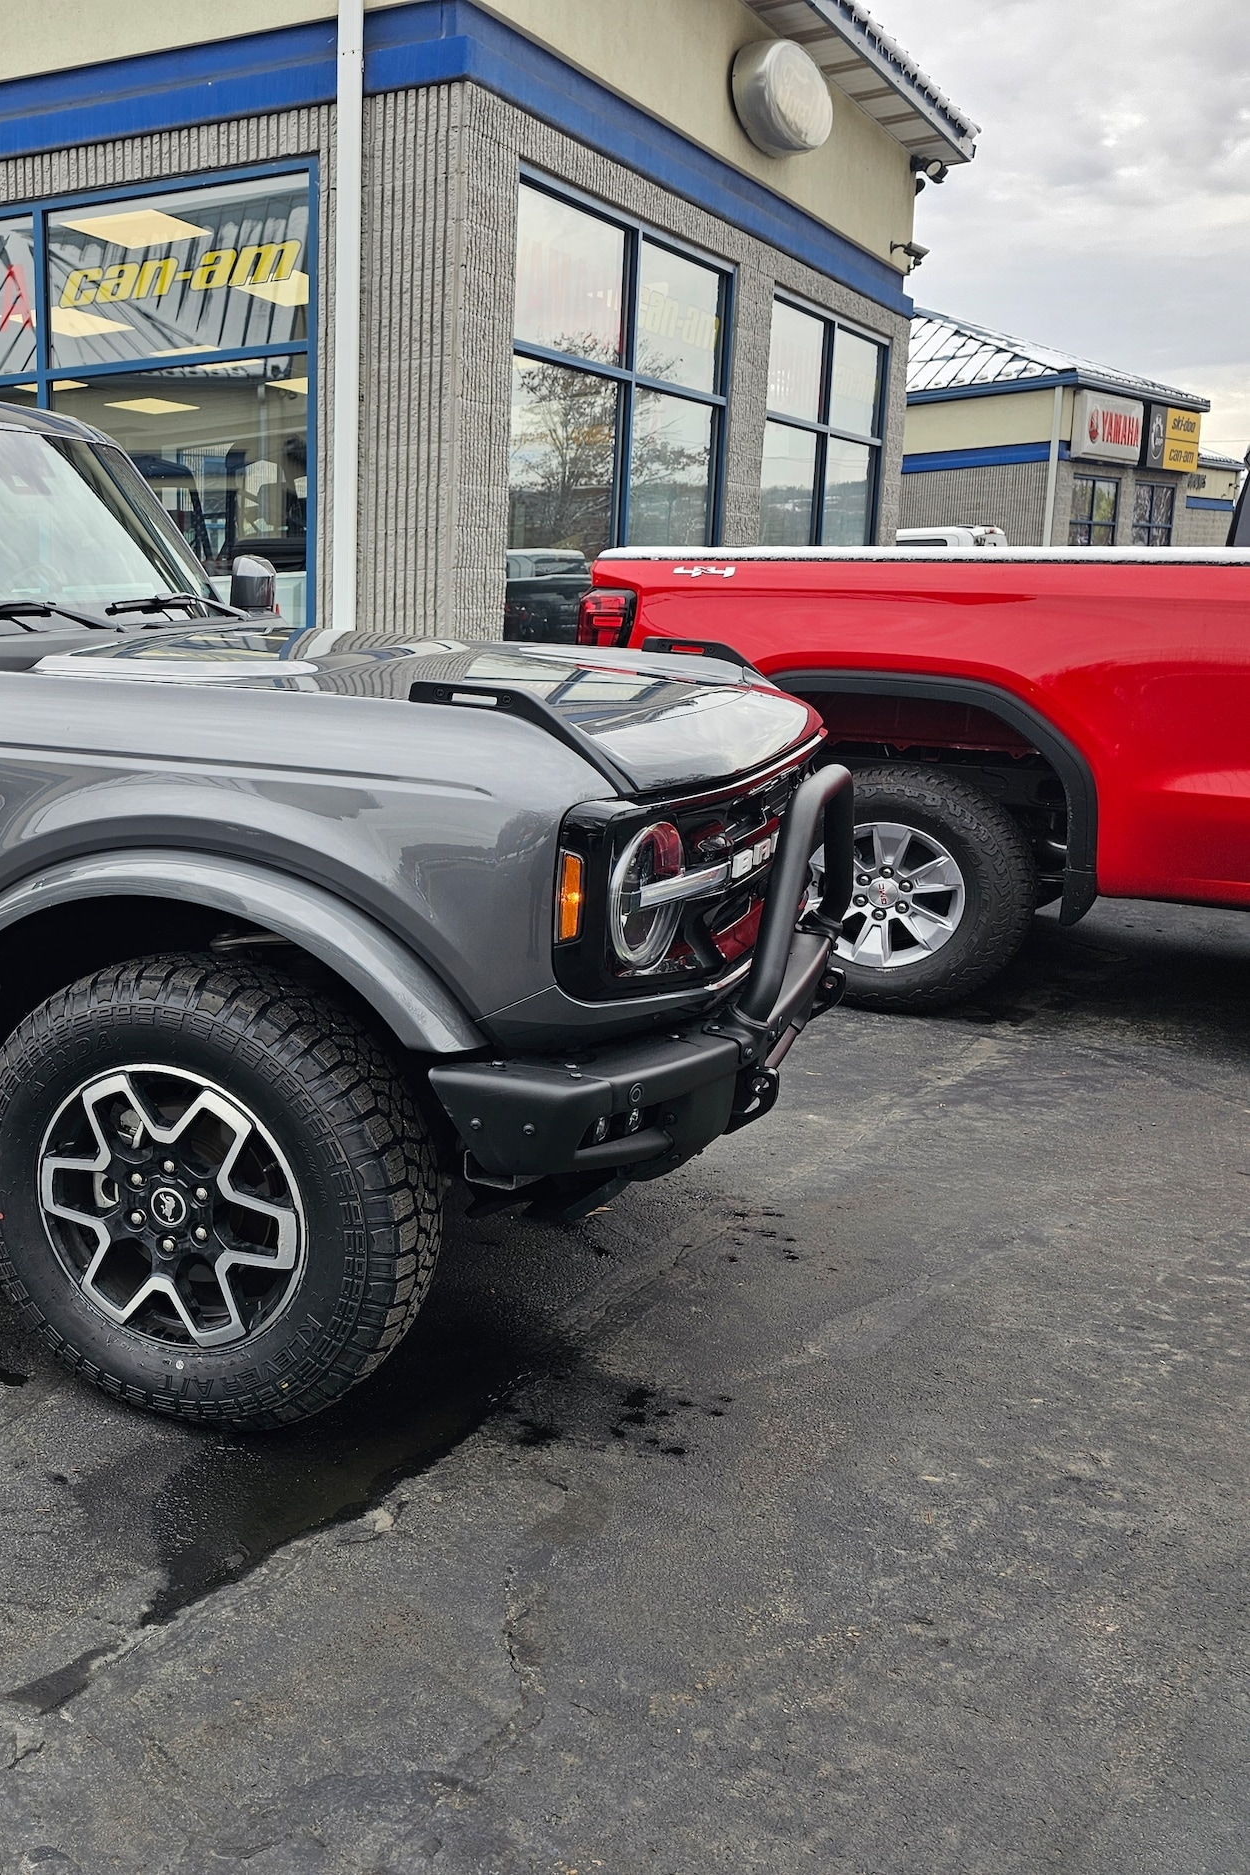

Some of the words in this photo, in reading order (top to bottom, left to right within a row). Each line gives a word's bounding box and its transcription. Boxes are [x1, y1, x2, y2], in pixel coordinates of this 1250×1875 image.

[59, 239, 302, 309] can-am
[1101, 410, 1140, 448] YAMAHA
[1171, 415, 1197, 433] ski-doo
[1168, 448, 1195, 464] can-am
[879, 883, 888, 905] GMC
[23, 1030, 113, 1099] KENDA
[218, 1313, 324, 1396] KLEVER
